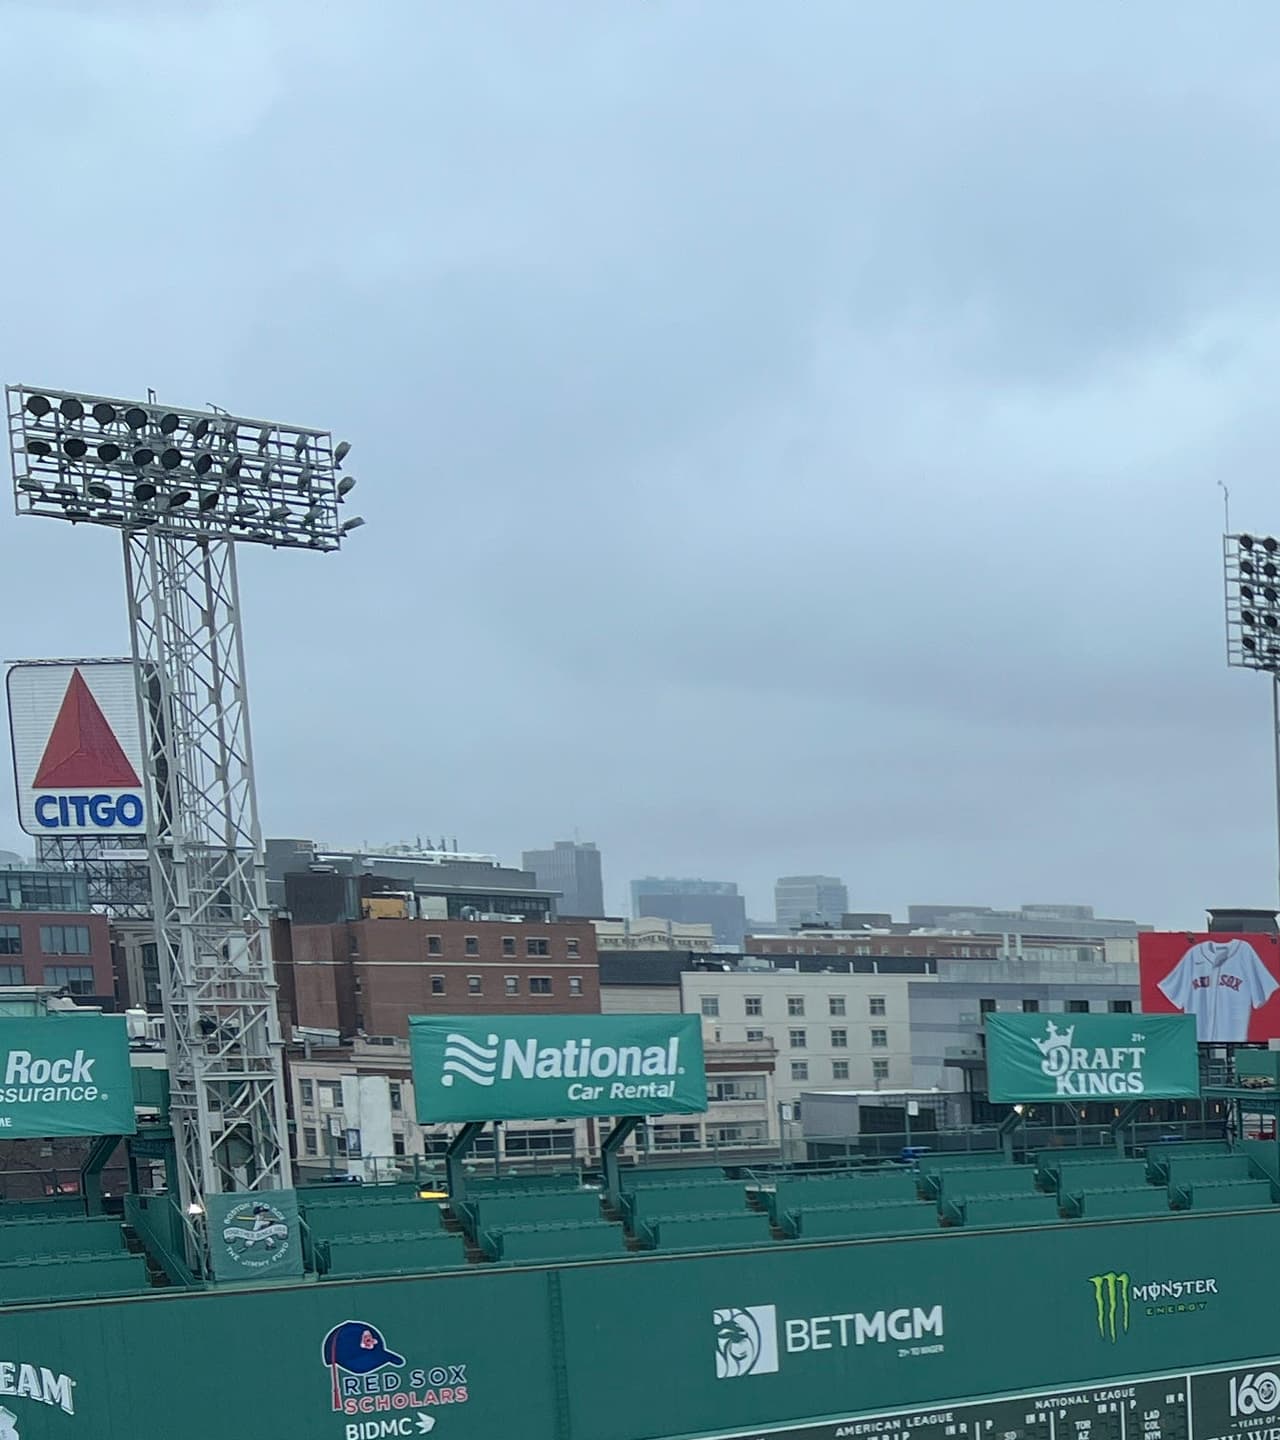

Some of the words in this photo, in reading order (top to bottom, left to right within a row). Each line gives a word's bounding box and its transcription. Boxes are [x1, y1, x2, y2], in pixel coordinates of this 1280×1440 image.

[34, 794, 144, 828] CITGO
[5, 1050, 96, 1085] Rock
[501, 1037, 680, 1080] National
[1041, 1045, 1146, 1077] DRAFT
[568, 1083, 603, 1100] Car
[610, 1081, 675, 1099] Rental
[1056, 1070, 1145, 1096] KINGS
[785, 1304, 944, 1352] BETMGM
[343, 1372, 401, 1396] RED
[410, 1364, 467, 1389] SOX
[344, 1386, 468, 1415] SCHOLARS
[1035, 1394, 1089, 1410] NATIONAL
[1094, 1387, 1135, 1402] LEAGUE
[835, 1419, 901, 1437] AMERICAN
[906, 1412, 953, 1428] LEAGUE
